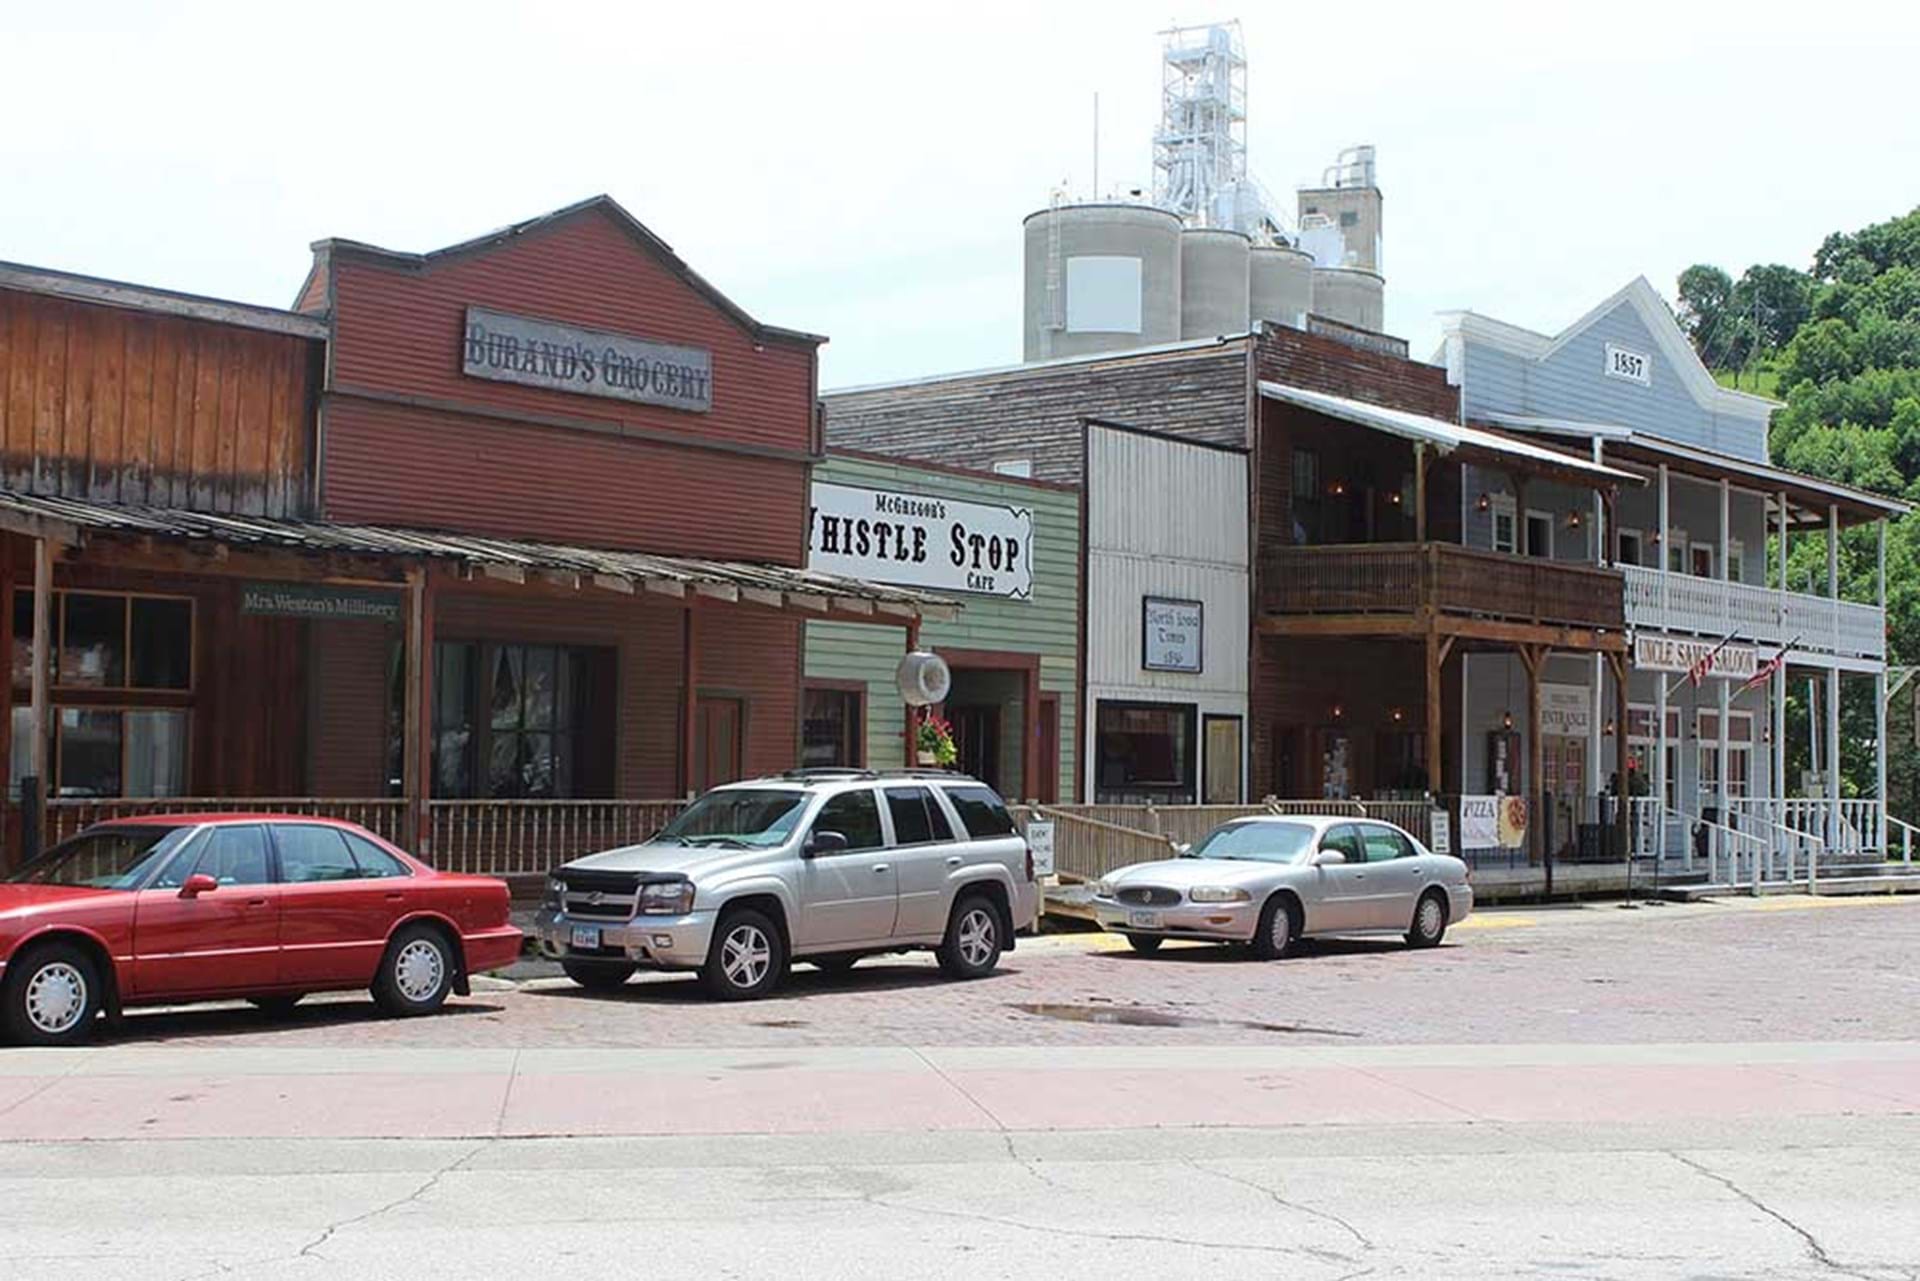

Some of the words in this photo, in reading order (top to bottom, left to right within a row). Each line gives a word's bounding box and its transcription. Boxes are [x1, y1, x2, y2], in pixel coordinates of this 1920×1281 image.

[467, 323, 596, 383] BURAND'S
[602, 347, 710, 401] GROCERY
[1614, 352, 1642, 377] 1857
[950, 522, 1019, 573] STOP
[335, 598, 398, 620] Millinery
[1640, 639, 1673, 665] UNCLE
[1541, 709, 1588, 729] ENTRANCE
[1463, 801, 1495, 818] PIZZA
